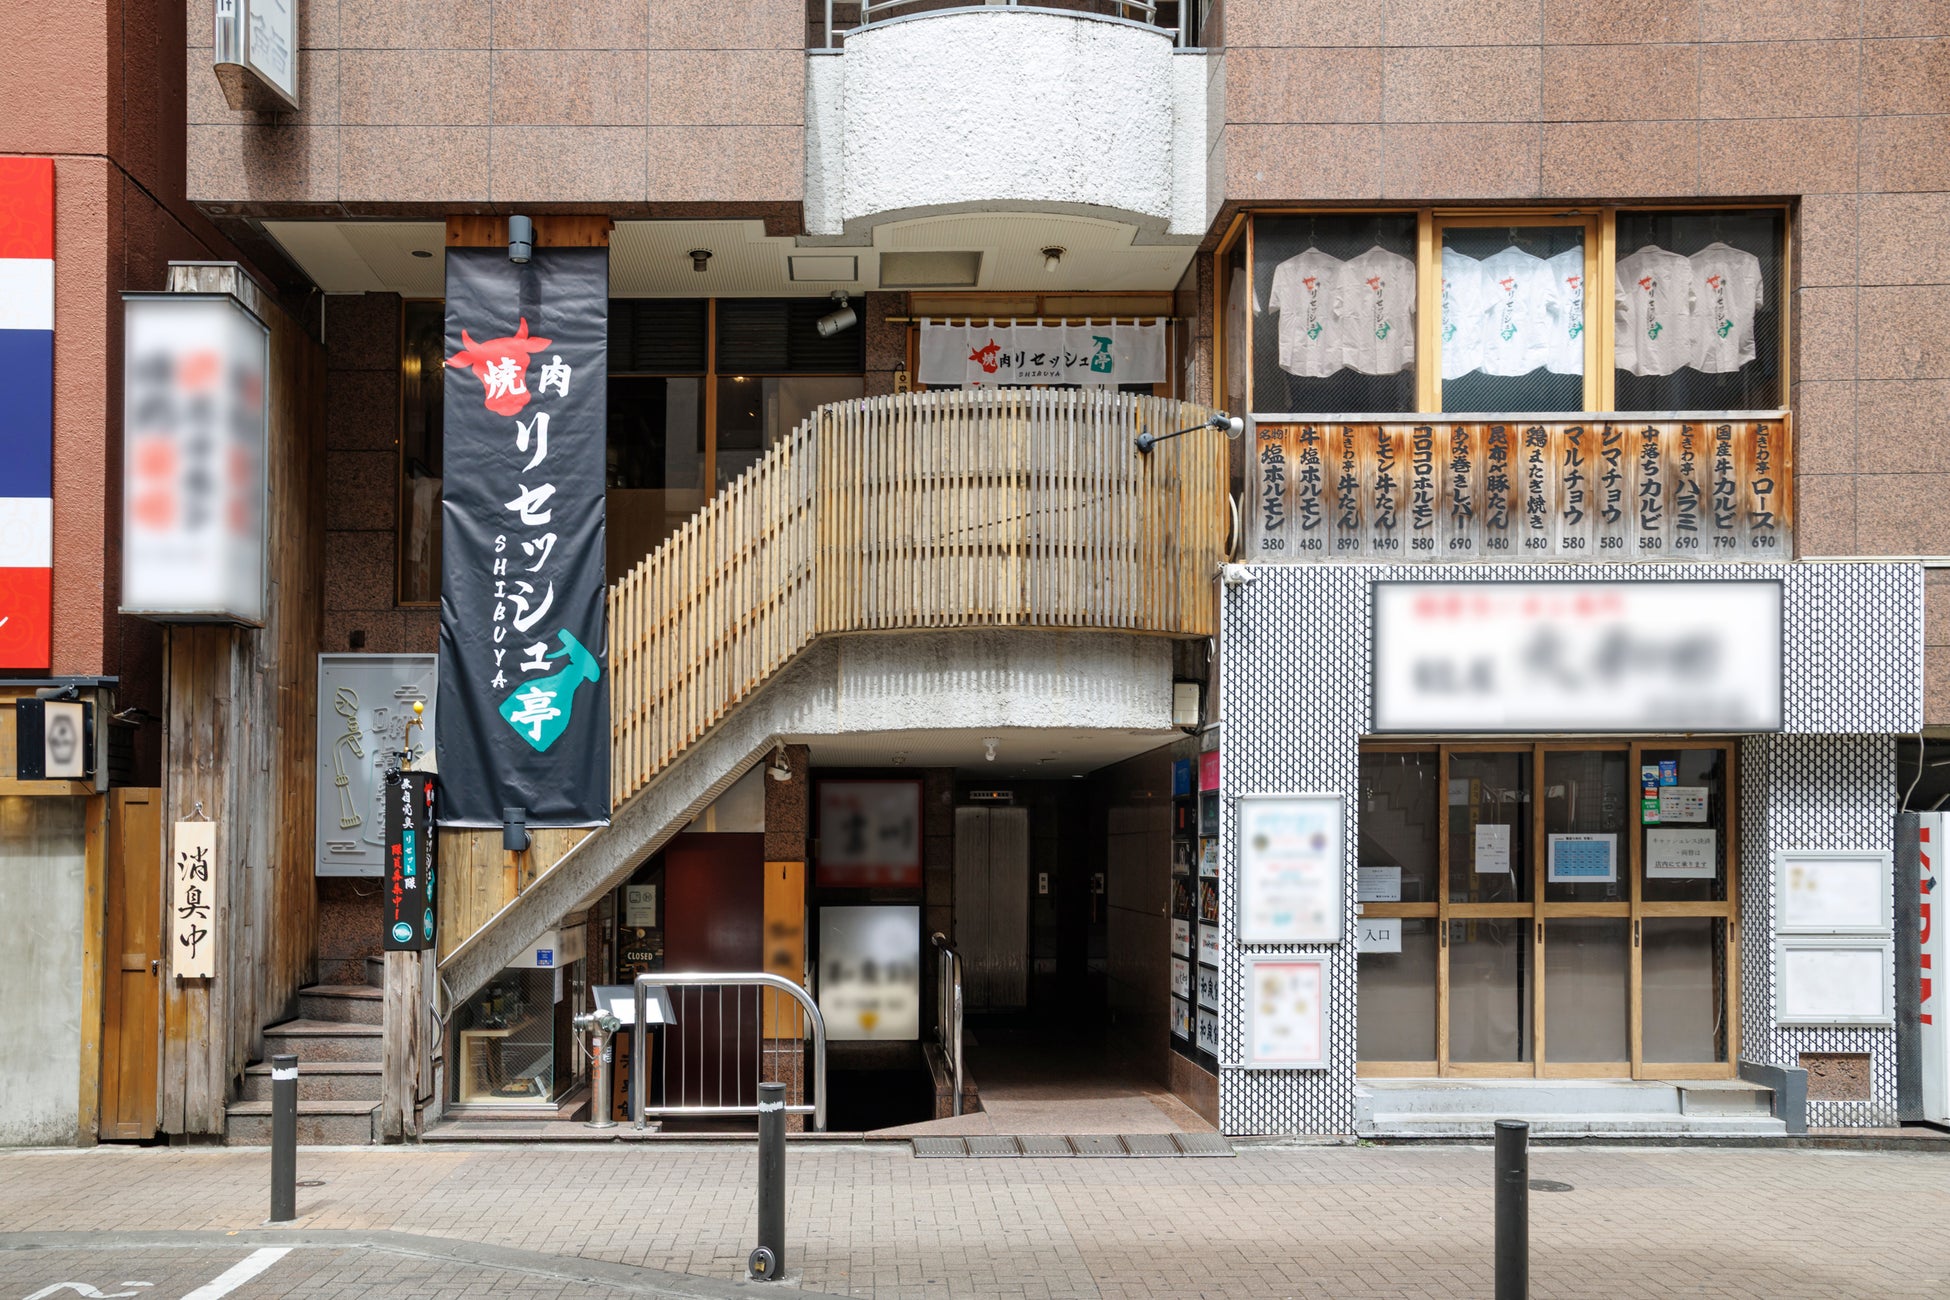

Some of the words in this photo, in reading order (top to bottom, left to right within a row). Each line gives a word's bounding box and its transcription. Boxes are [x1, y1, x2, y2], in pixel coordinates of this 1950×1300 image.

[982, 351, 1112, 370] 焼肉リセッシュ亭
[483, 354, 572, 400] 焼肉
[1259, 428, 1288, 440] 名物!
[1299, 426, 1322, 531] 牛塩ホルモン
[1374, 426, 1397, 530] レモン牛たん
[1412, 426, 1434, 530] コロコロホルモン
[1450, 426, 1473, 529] あみ巻きレバー
[1563, 426, 1585, 526] マルチョウ
[1601, 424, 1623, 525] シマチョウ
[1639, 425, 1663, 531] 中落ちカルビ
[1712, 424, 1737, 530] 国産牛カルビ
[1260, 443, 1286, 531] 塩ホルモン
[1261, 538, 1285, 550] 380
[1300, 538, 1323, 550] 480
[1337, 538, 1360, 550] 890
[1372, 538, 1399, 550] 1490
[1411, 538, 1435, 550] 580
[1449, 538, 1472, 550] 690
[1487, 538, 1509, 550] 480
[1525, 537, 1547, 549] 480
[1562, 537, 1585, 549] 580
[1600, 536, 1623, 549] 580
[1639, 536, 1662, 549] 580
[1675, 536, 1699, 549] 690
[1713, 536, 1736, 548] 790
[1751, 535, 1775, 548] 690
[504, 411, 561, 742] リセッシュ亭
[491, 534, 508, 689] SHIBUYA
[177, 845, 211, 960] 消臭中
[1363, 928, 1390, 942] 入口
[627, 952, 653, 960] CLOSED
